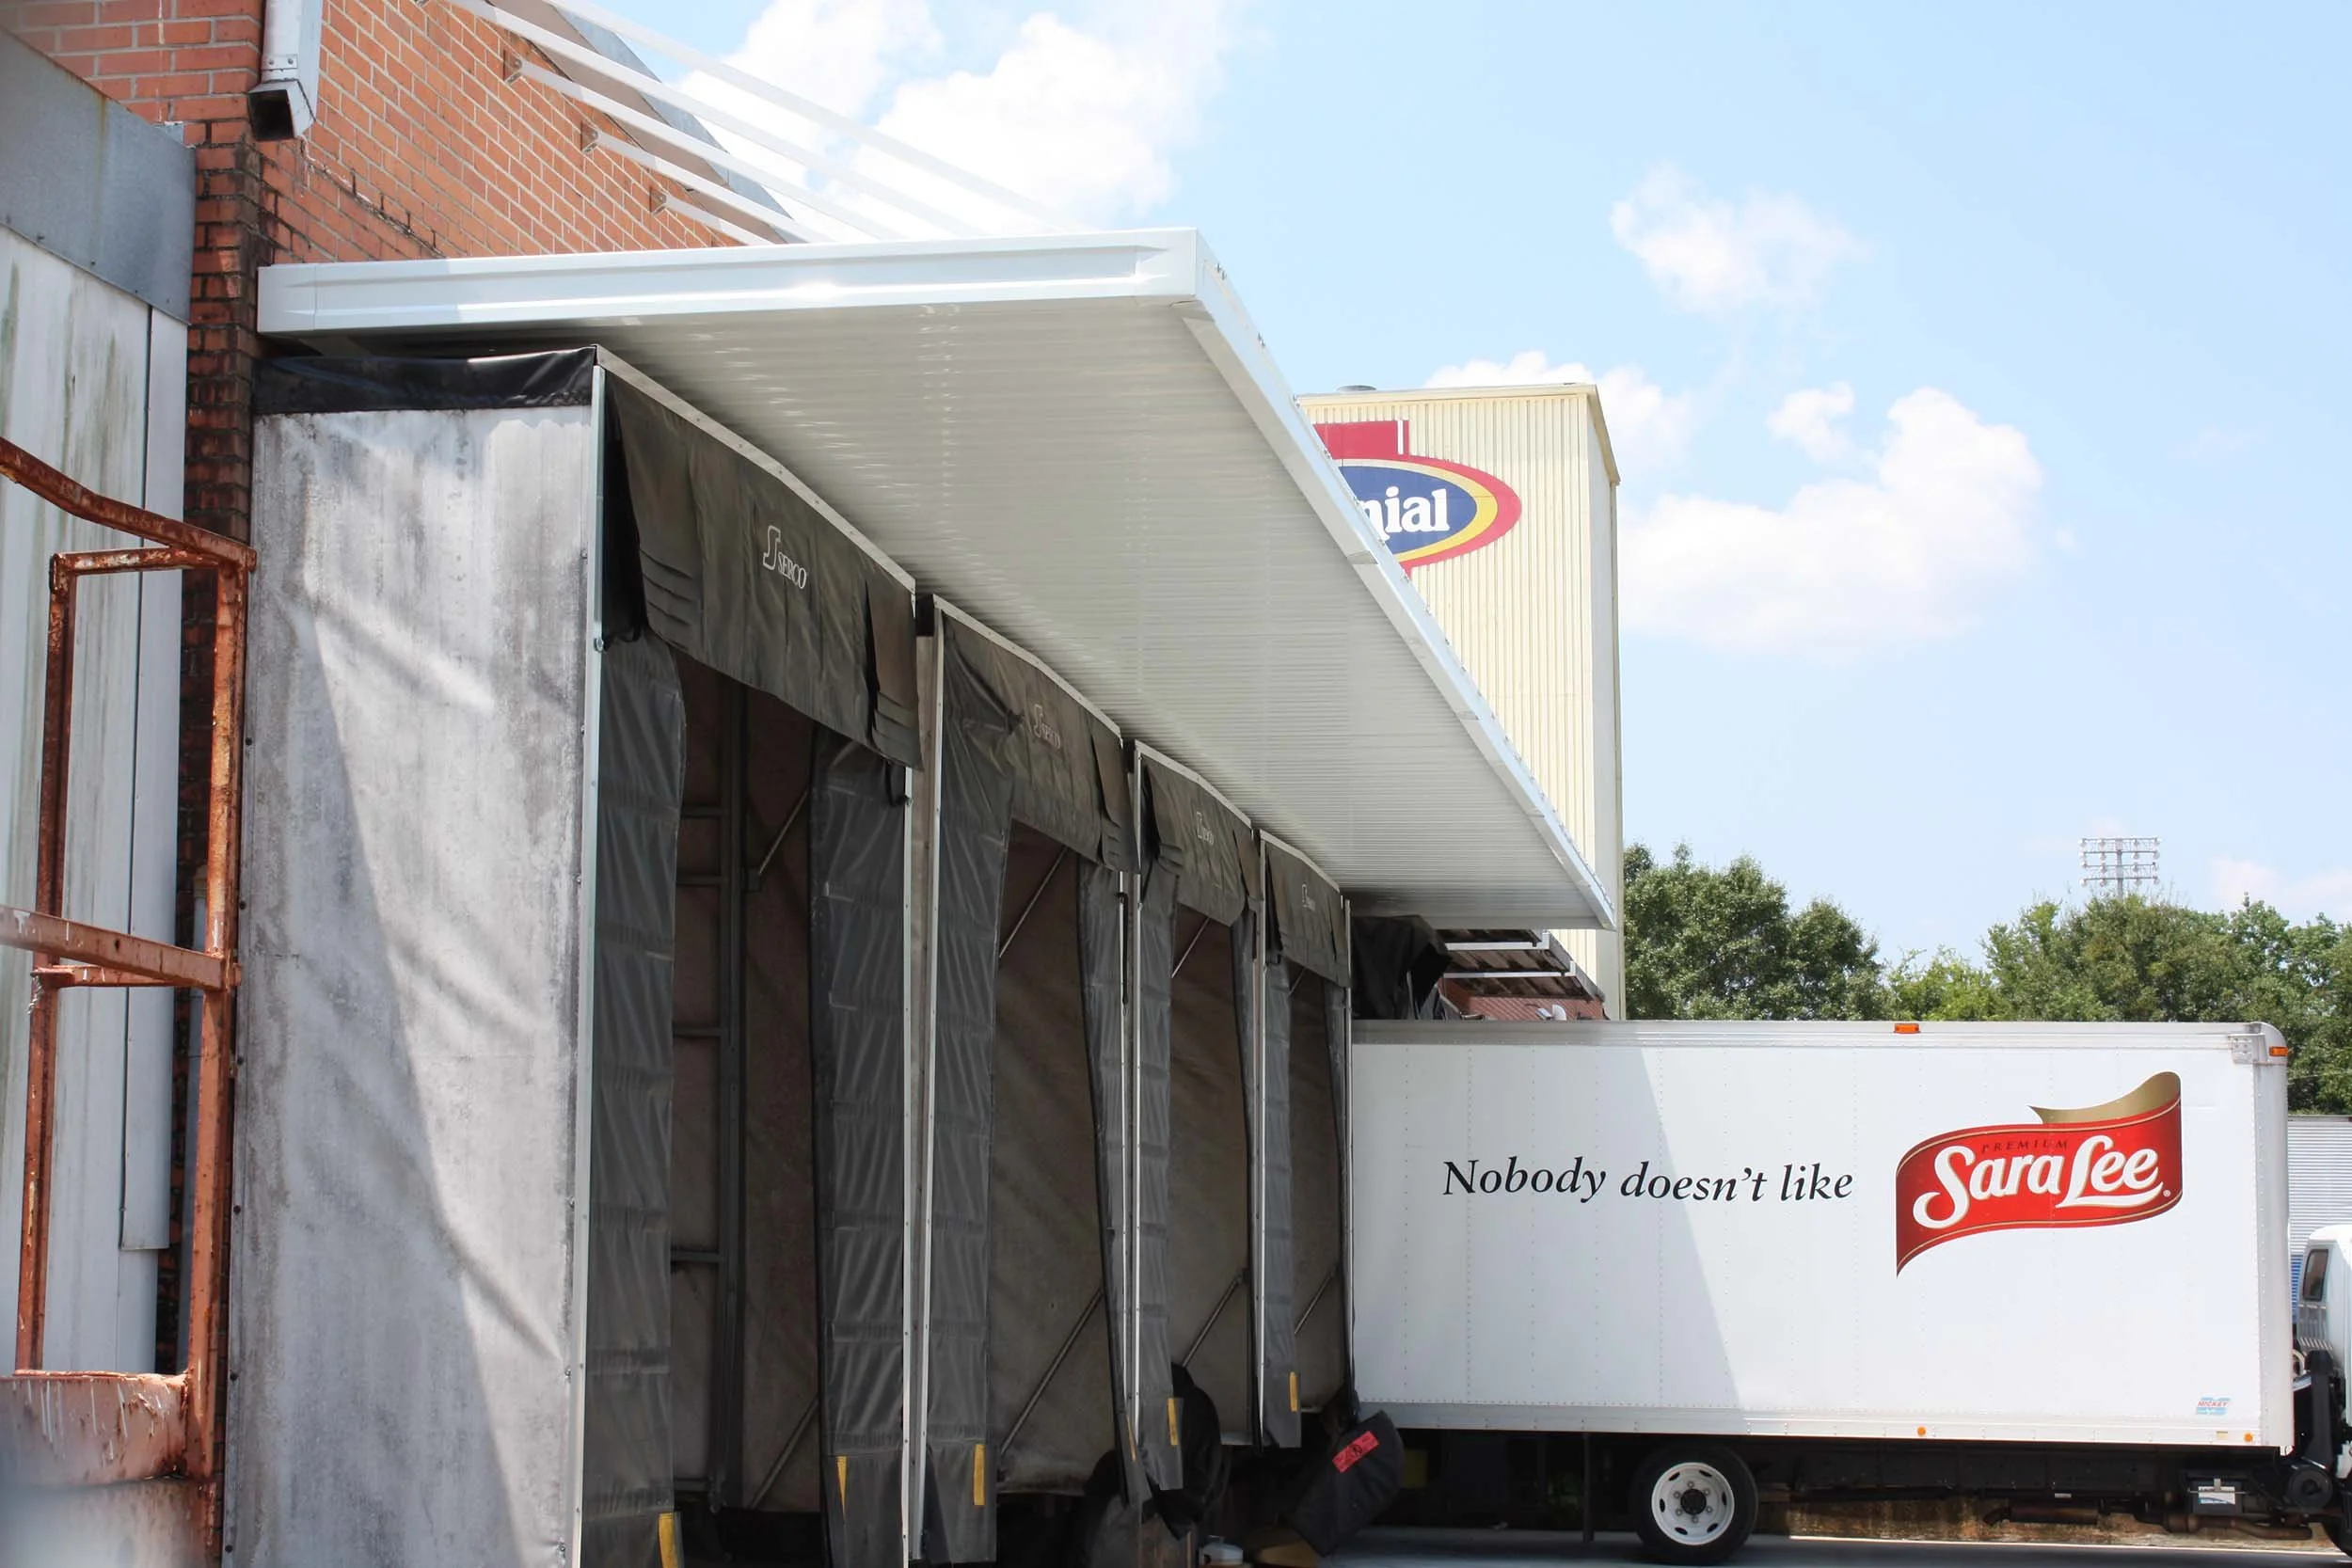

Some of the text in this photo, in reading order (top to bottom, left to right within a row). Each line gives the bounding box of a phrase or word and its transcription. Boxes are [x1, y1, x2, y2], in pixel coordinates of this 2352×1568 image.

[777, 551, 807, 590] SERCO
[1981, 1138, 2068, 1154] PREMIUM
[1442, 1155, 1607, 1204] Nobody
[1780, 1162, 1853, 1202] like
[1912, 1134, 2164, 1229] Sara Lee
